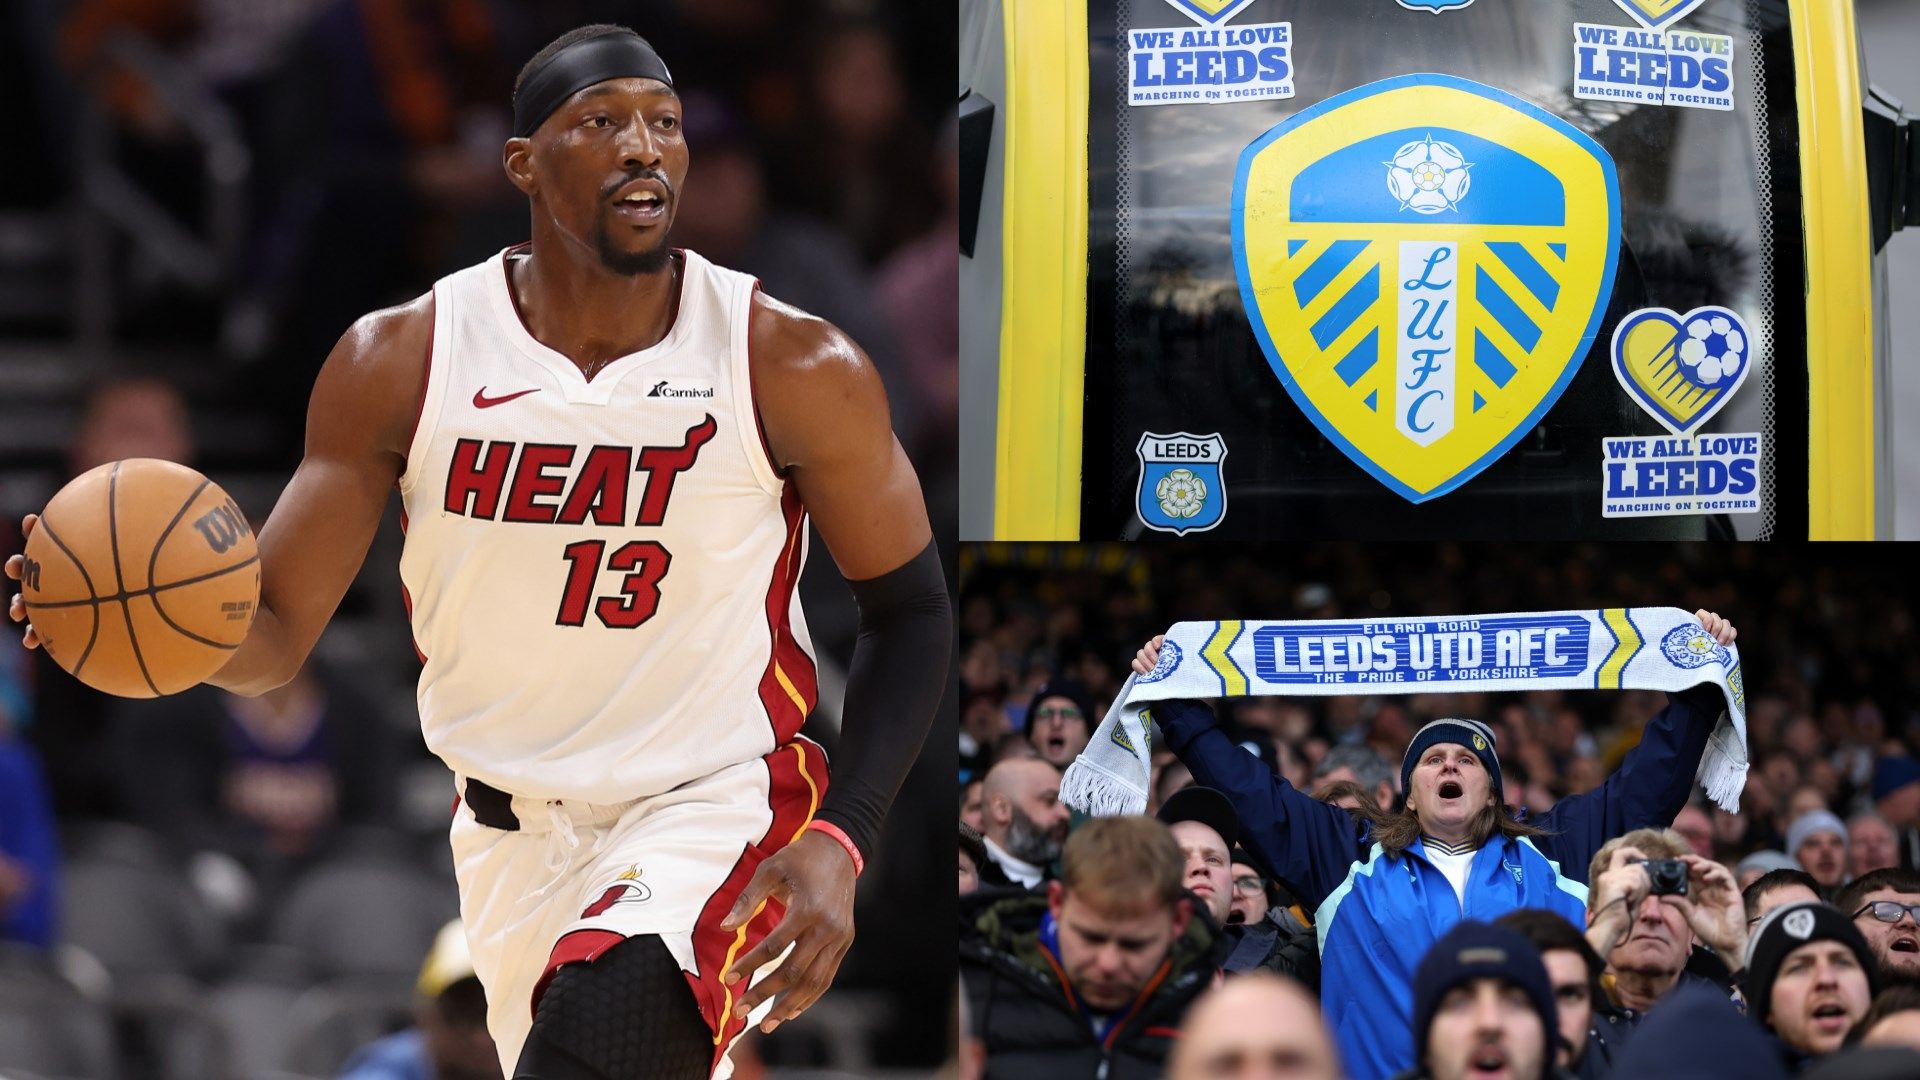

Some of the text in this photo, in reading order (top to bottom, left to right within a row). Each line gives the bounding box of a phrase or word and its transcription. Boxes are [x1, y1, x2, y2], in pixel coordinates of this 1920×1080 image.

[1134, 32, 1174, 49] WE
[1225, 27, 1288, 46] LOVE
[1578, 26, 1729, 55] WE ALL LOVE
[1133, 47, 1289, 87] LEEDS
[1578, 47, 1729, 92] LEEDS
[1134, 86, 1291, 101] MARCHING ON TOGETHER
[1578, 85, 1730, 106] MARCHING ON TOGETHER
[1403, 247, 1452, 433] LUFC
[662, 387, 714, 398] Carnival
[1155, 443, 1211, 458] LEEDS
[1607, 437, 1758, 458] WE ALL LOVE
[444, 412, 717, 527] HEAT
[1606, 458, 1756, 498] LEEDS
[1607, 500, 1757, 513] MARCHING ON TOGETHER
[555, 539, 672, 629] 13
[1363, 620, 1481, 634] ELLAND ROAD
[1273, 627, 1570, 673] LEEDS UTD AFC
[1313, 667, 1539, 683] THE PRIDE OF YORKSHIRE
